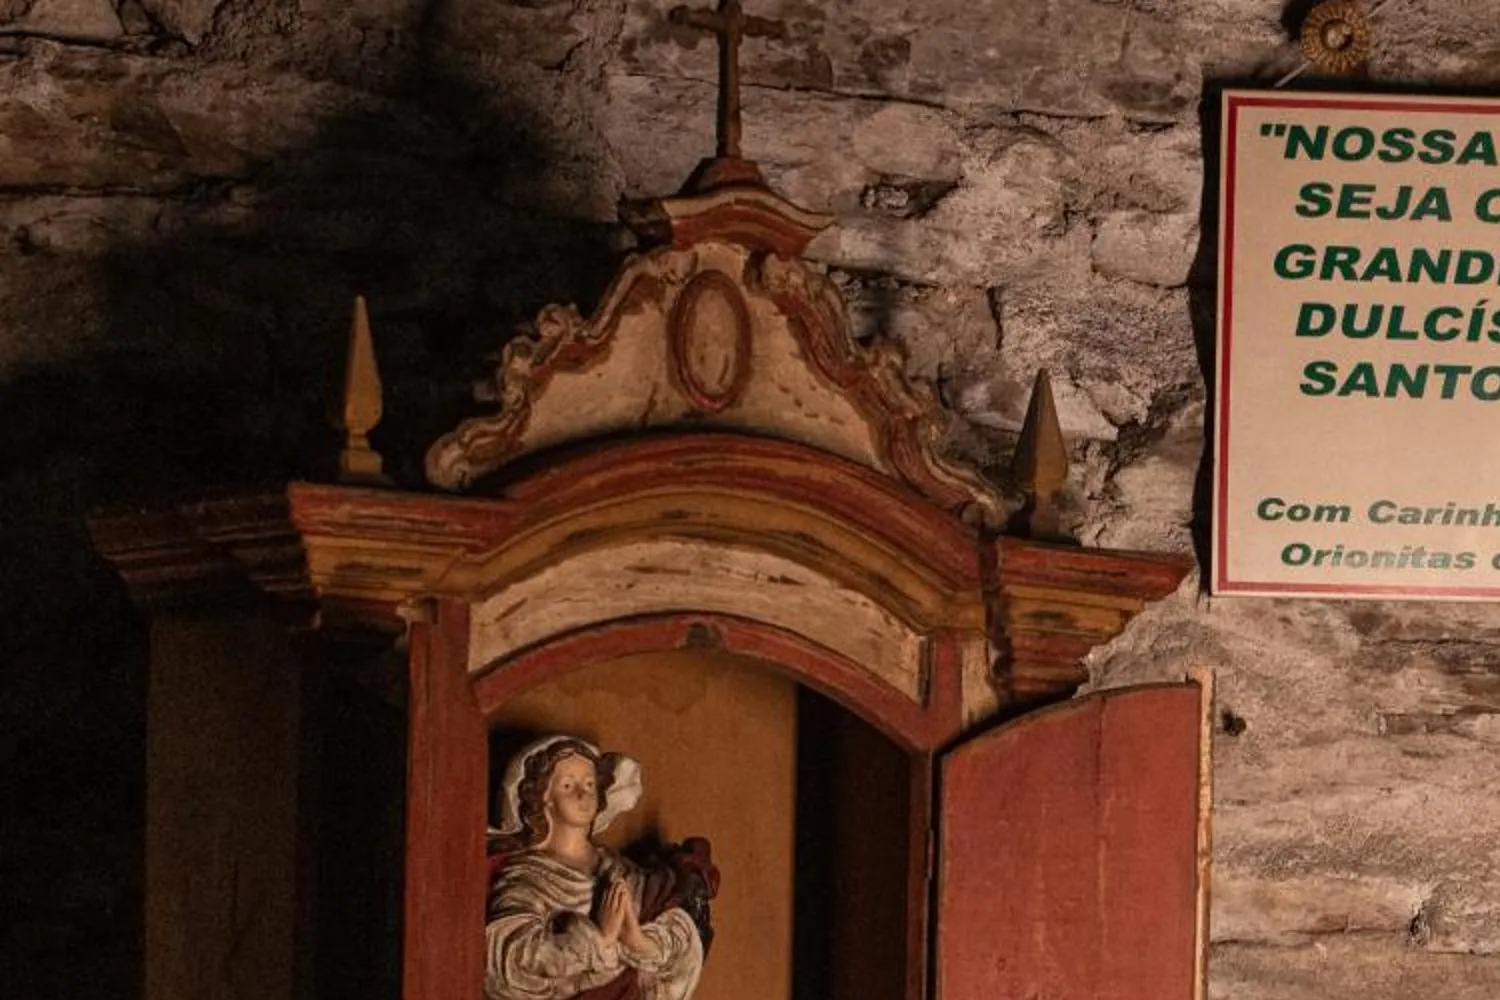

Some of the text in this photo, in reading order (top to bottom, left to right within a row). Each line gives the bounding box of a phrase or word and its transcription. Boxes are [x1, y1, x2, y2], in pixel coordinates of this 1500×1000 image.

[1260, 123, 1499, 167] "NOSSA
[1294, 182, 1452, 222] SEJA
[1257, 498, 1351, 522] Com
[1281, 543, 1476, 569] Orionitas
